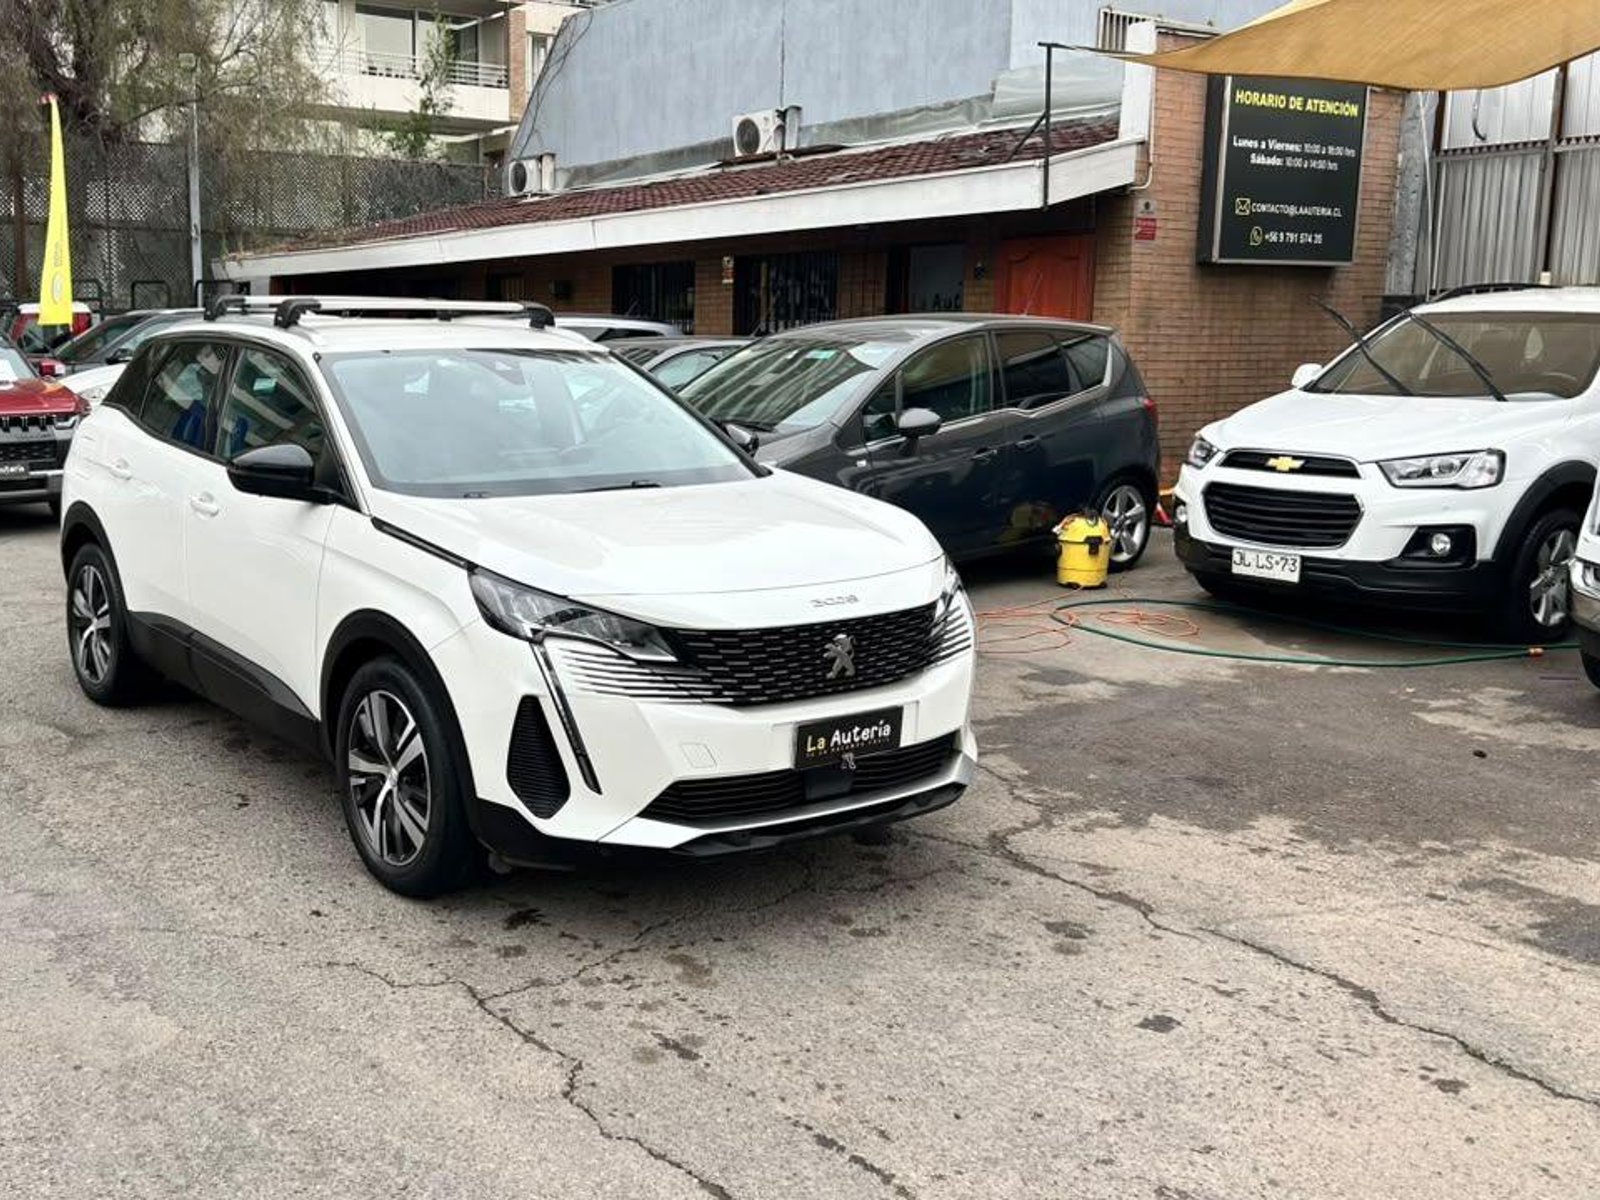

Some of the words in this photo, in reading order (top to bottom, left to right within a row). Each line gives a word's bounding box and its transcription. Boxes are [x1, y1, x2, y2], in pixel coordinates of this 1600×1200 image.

[1235, 89, 1286, 109] HORARIO
[1289, 95, 1304, 110] DE
[1305, 98, 1359, 117] ATENCIÓN
[1233, 135, 1259, 149] Lunes
[1261, 141, 1266, 149] a
[1268, 139, 1302, 152] Viernes:
[1321, 146, 1326, 154] a
[1250, 152, 1284, 166] Sábado:
[1303, 160, 1308, 168] a
[1265, 231, 1278, 242] +56
[1233, 551, 1251, 567] JL
[807, 735, 826, 752] La
[830, 720, 891, 747] Autería
